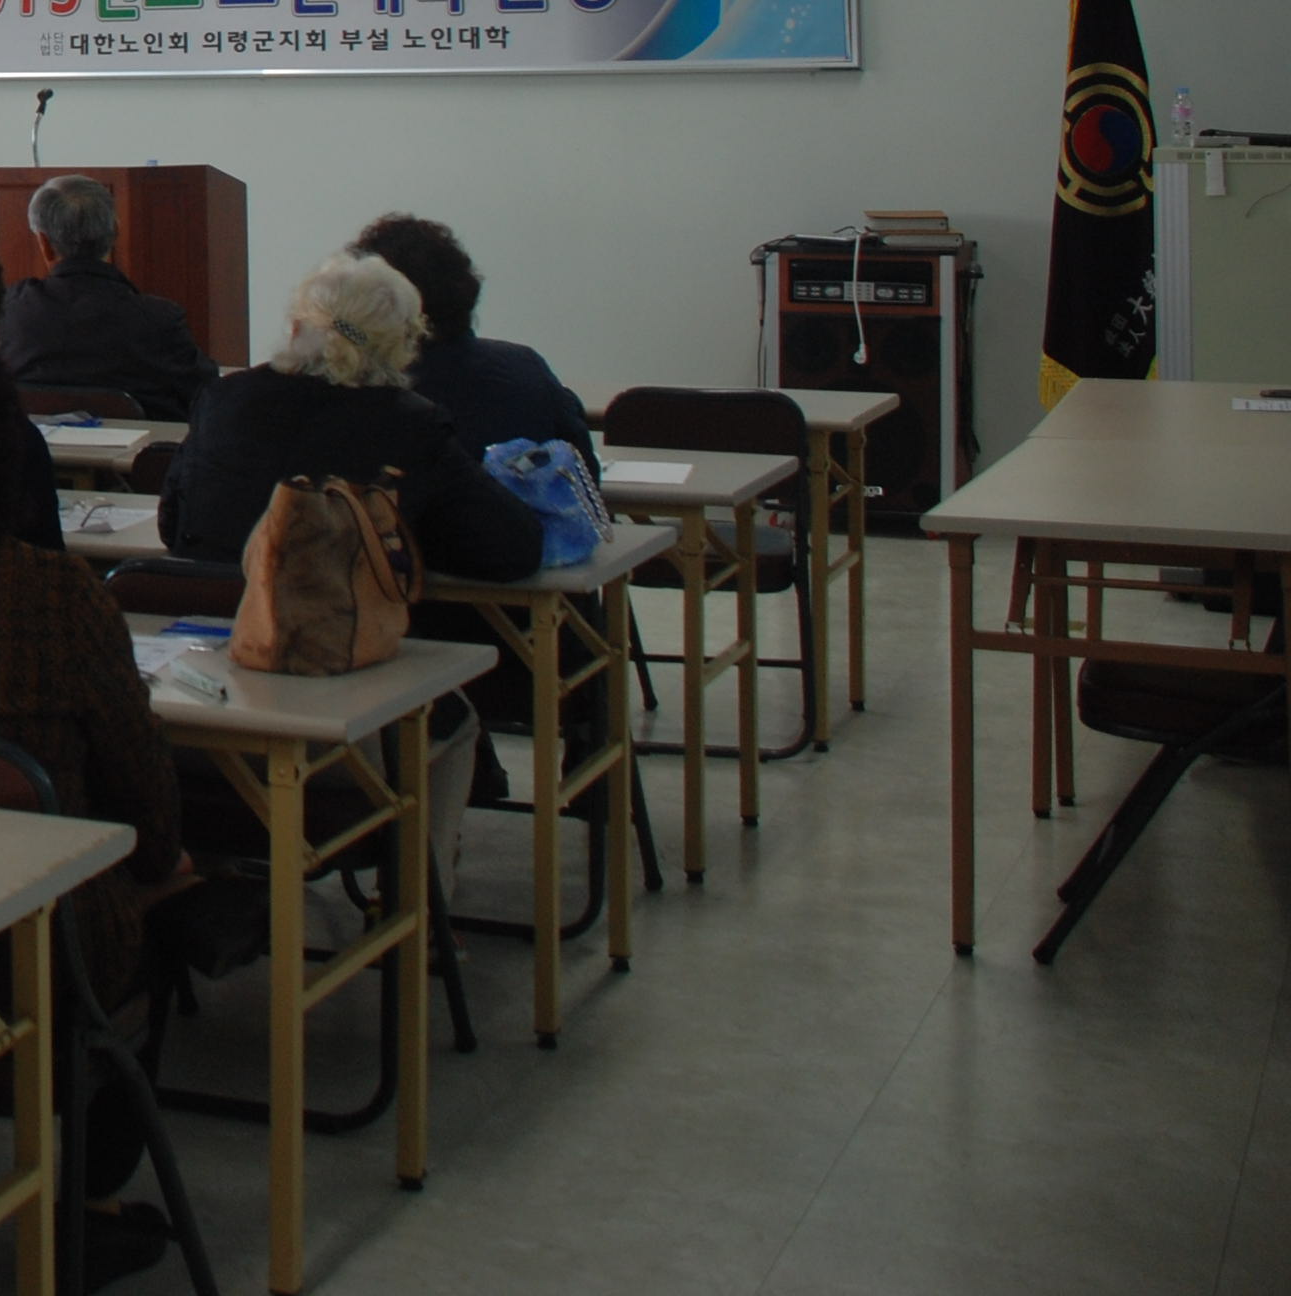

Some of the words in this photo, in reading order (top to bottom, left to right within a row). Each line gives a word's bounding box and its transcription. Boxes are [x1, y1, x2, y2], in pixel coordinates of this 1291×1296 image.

[70, 30, 189, 56] 대한노인회
[202, 28, 327, 54] 의령군지회
[340, 26, 389, 51] 부설
[402, 25, 510, 50] 노인대학
